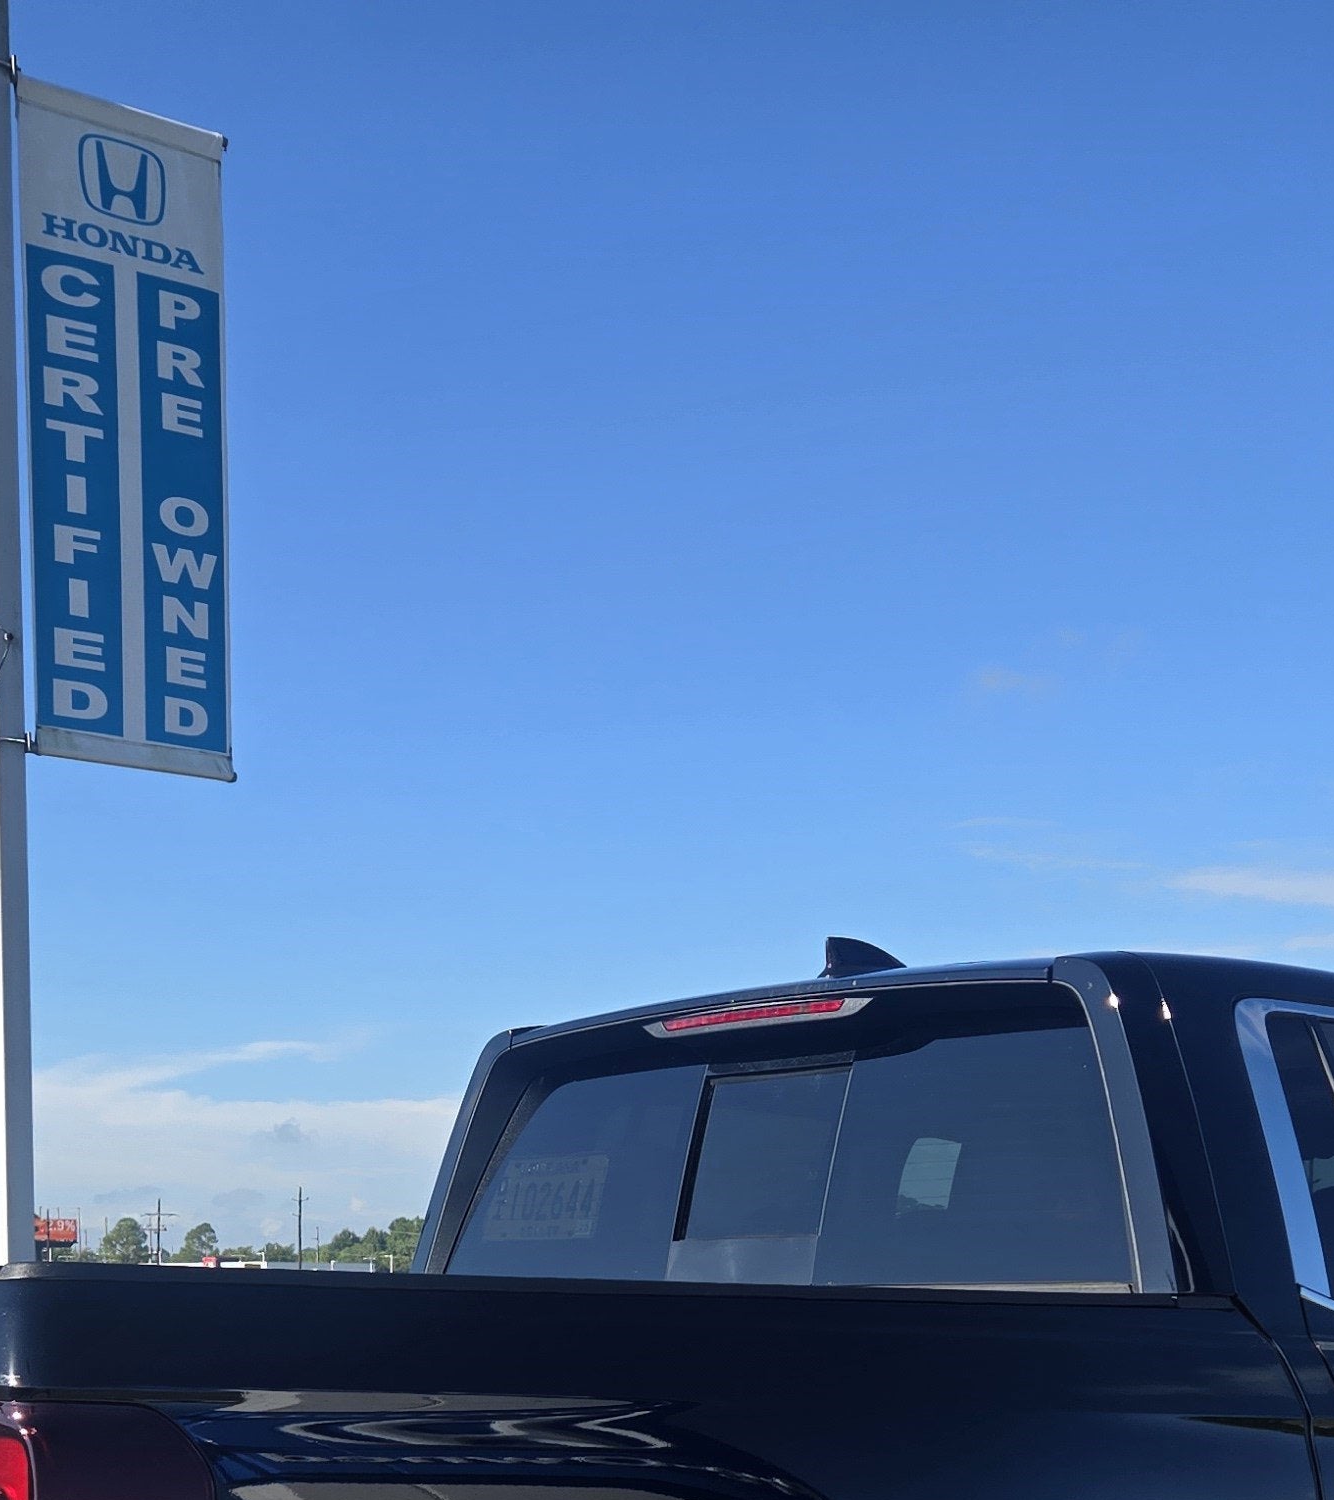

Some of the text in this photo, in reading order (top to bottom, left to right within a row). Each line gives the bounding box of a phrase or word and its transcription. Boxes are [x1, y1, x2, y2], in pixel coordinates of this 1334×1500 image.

[41, 212, 205, 275] HONDA
[40, 264, 109, 722] CERTIFIED
[151, 289, 218, 738] PRE OWNED
